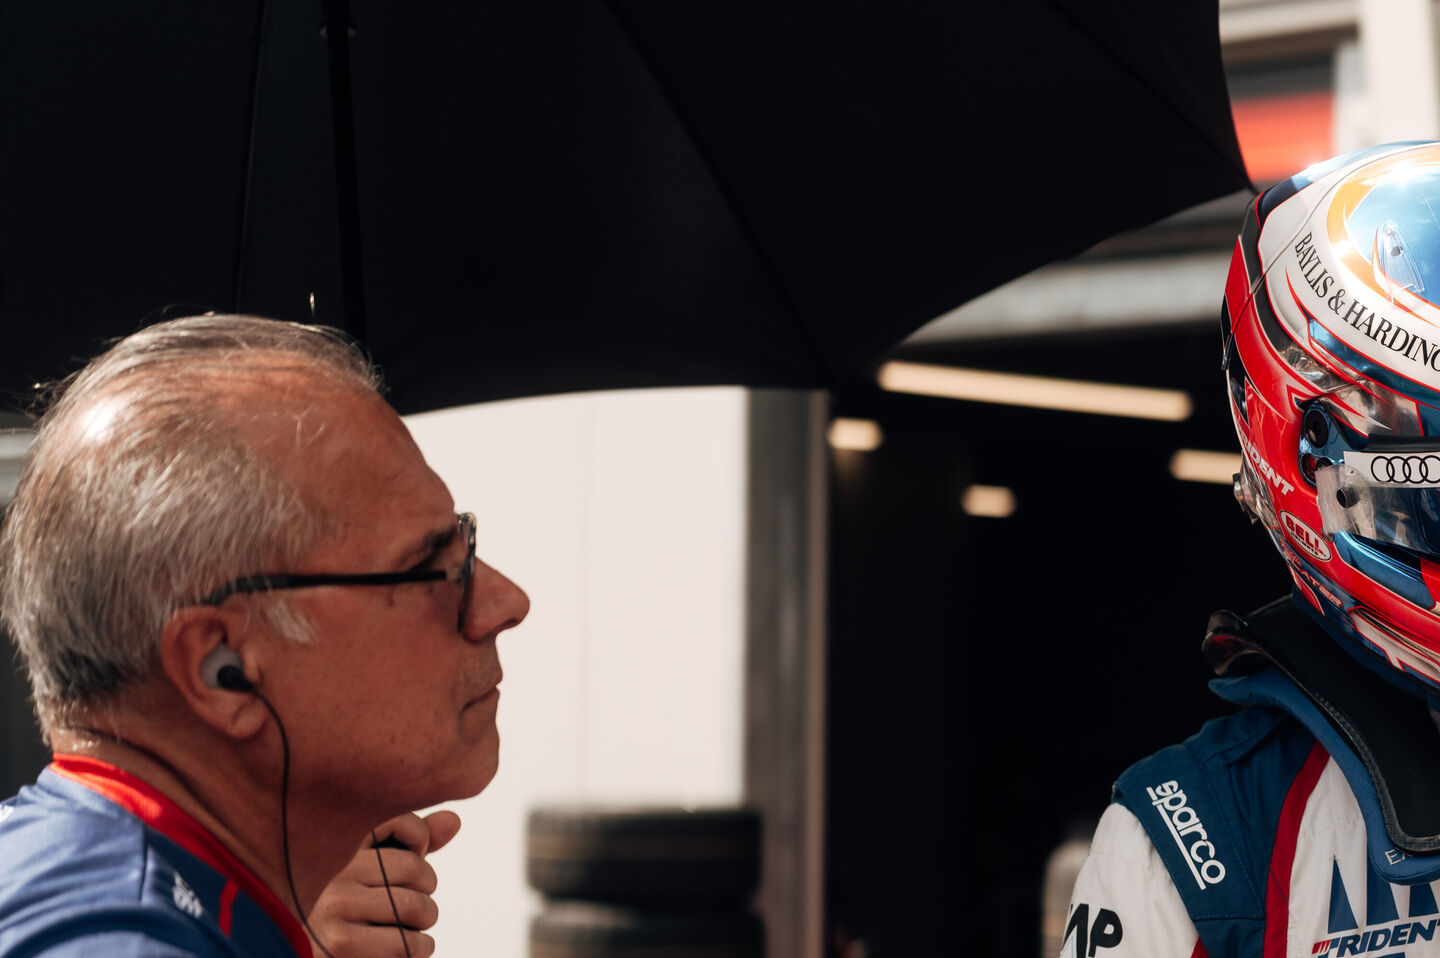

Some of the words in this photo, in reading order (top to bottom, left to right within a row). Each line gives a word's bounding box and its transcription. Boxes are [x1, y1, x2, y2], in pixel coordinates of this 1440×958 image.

[1295, 232, 1335, 298] BAYLIS
[1328, 289, 1346, 315] &
[1286, 515, 1324, 556] BELL
[1147, 780, 1226, 891] sparco
